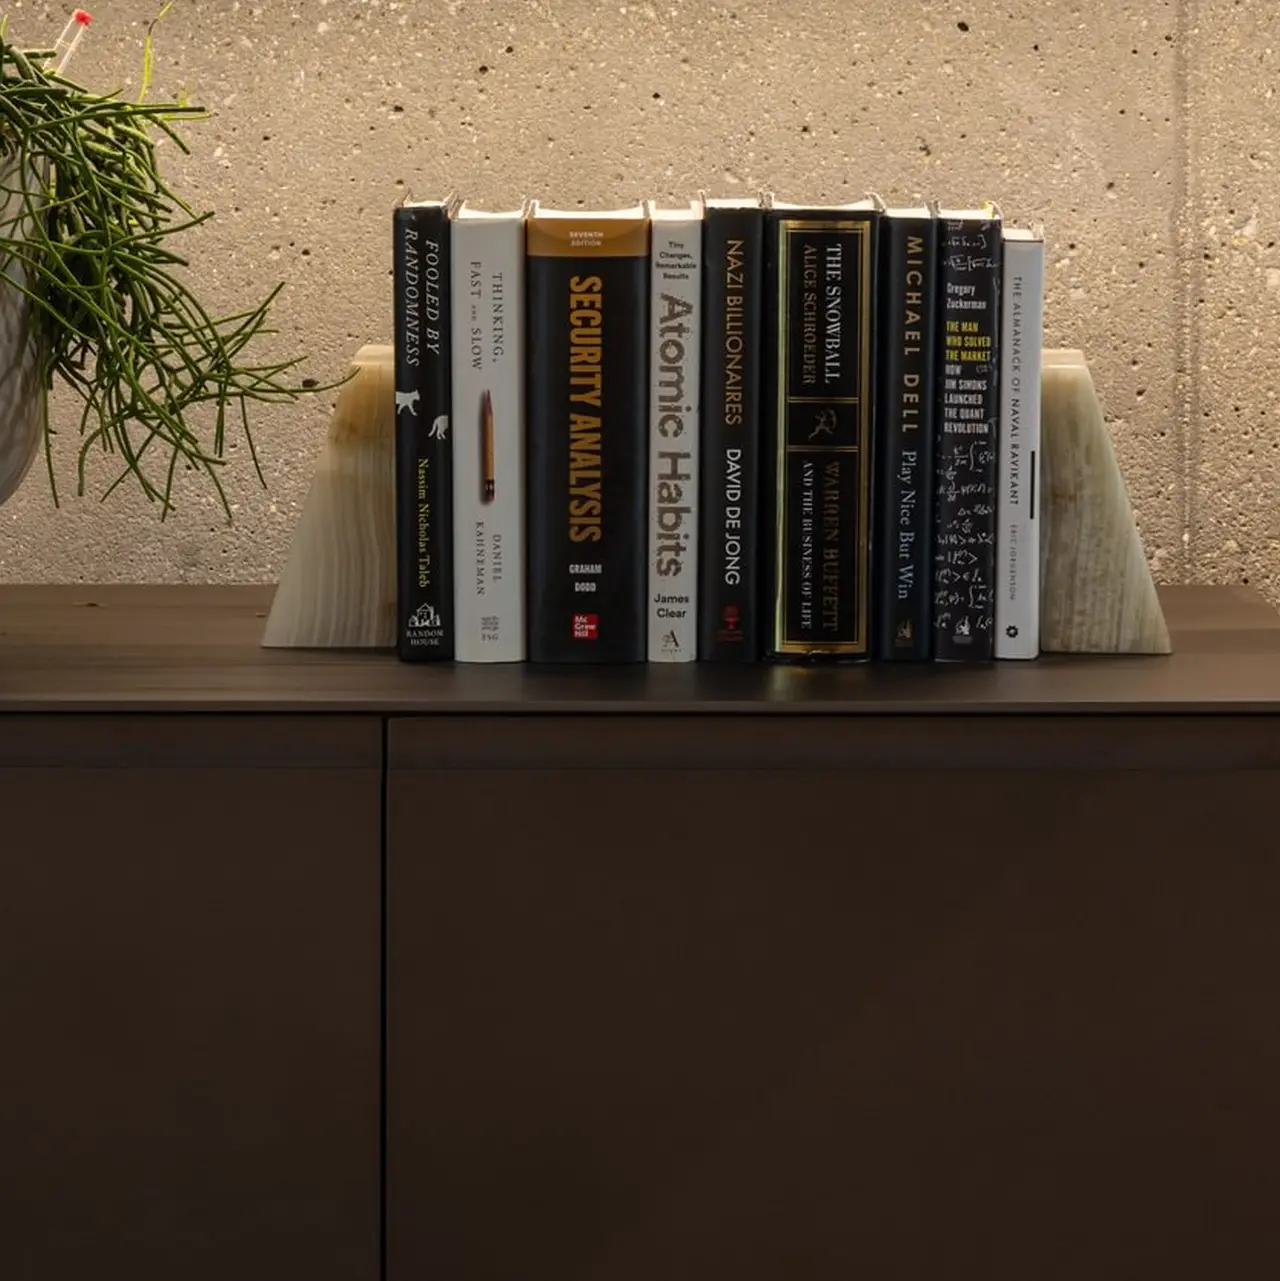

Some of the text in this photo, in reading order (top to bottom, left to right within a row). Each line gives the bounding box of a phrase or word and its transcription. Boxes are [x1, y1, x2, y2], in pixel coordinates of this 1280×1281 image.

[404, 228, 420, 368] RANDOMNESS
[425, 240, 440, 356] FOOLED BY
[470, 261, 482, 299] FAST
[946, 282, 976, 297] Gregory
[946, 298, 987, 310] Zuckerman
[492, 272, 504, 363] THINKING,
[725, 239, 744, 426] NAZI BILLIONAIRES
[803, 243, 818, 385] ALICE SCHROEDER
[824, 243, 842, 384] THE SNOWBALL
[902, 236, 924, 432] MICHAEL DELL
[946, 320, 979, 333] THE MAN
[471, 327, 483, 371] SLOW
[945, 349, 991, 361] THE MARKET
[946, 335, 991, 348] WHO SOLVED
[944, 378, 987, 391] JIM SIMONS
[945, 363, 962, 375] HOW
[1009, 276, 1023, 506] THE ALMANACK OF NAVAL RAVIKANT
[568, 275, 602, 543] SECURITY ANALYSIS
[944, 392, 984, 405] LAUNCHED
[944, 407, 985, 420] THE QUANT
[655, 292, 694, 578] Atomic Habits
[943, 421, 990, 434] REVOLUTION
[418, 458, 431, 588] Nassim Nicholas Taleb
[724, 448, 742, 585] DAVID DE JONG
[897, 451, 917, 600] Play Nice But Win
[475, 521, 486, 596] KAHNEMAN
[492, 533, 503, 583] DANIEL
[568, 563, 602, 574] GRAHAM
[800, 460, 814, 630] AND THE BUSINESS OF LIFE
[822, 461, 841, 632] WARREN BUFFETT
[574, 581, 597, 592] DODD
[653, 593, 690, 603] James
[656, 608, 688, 619] Clear
